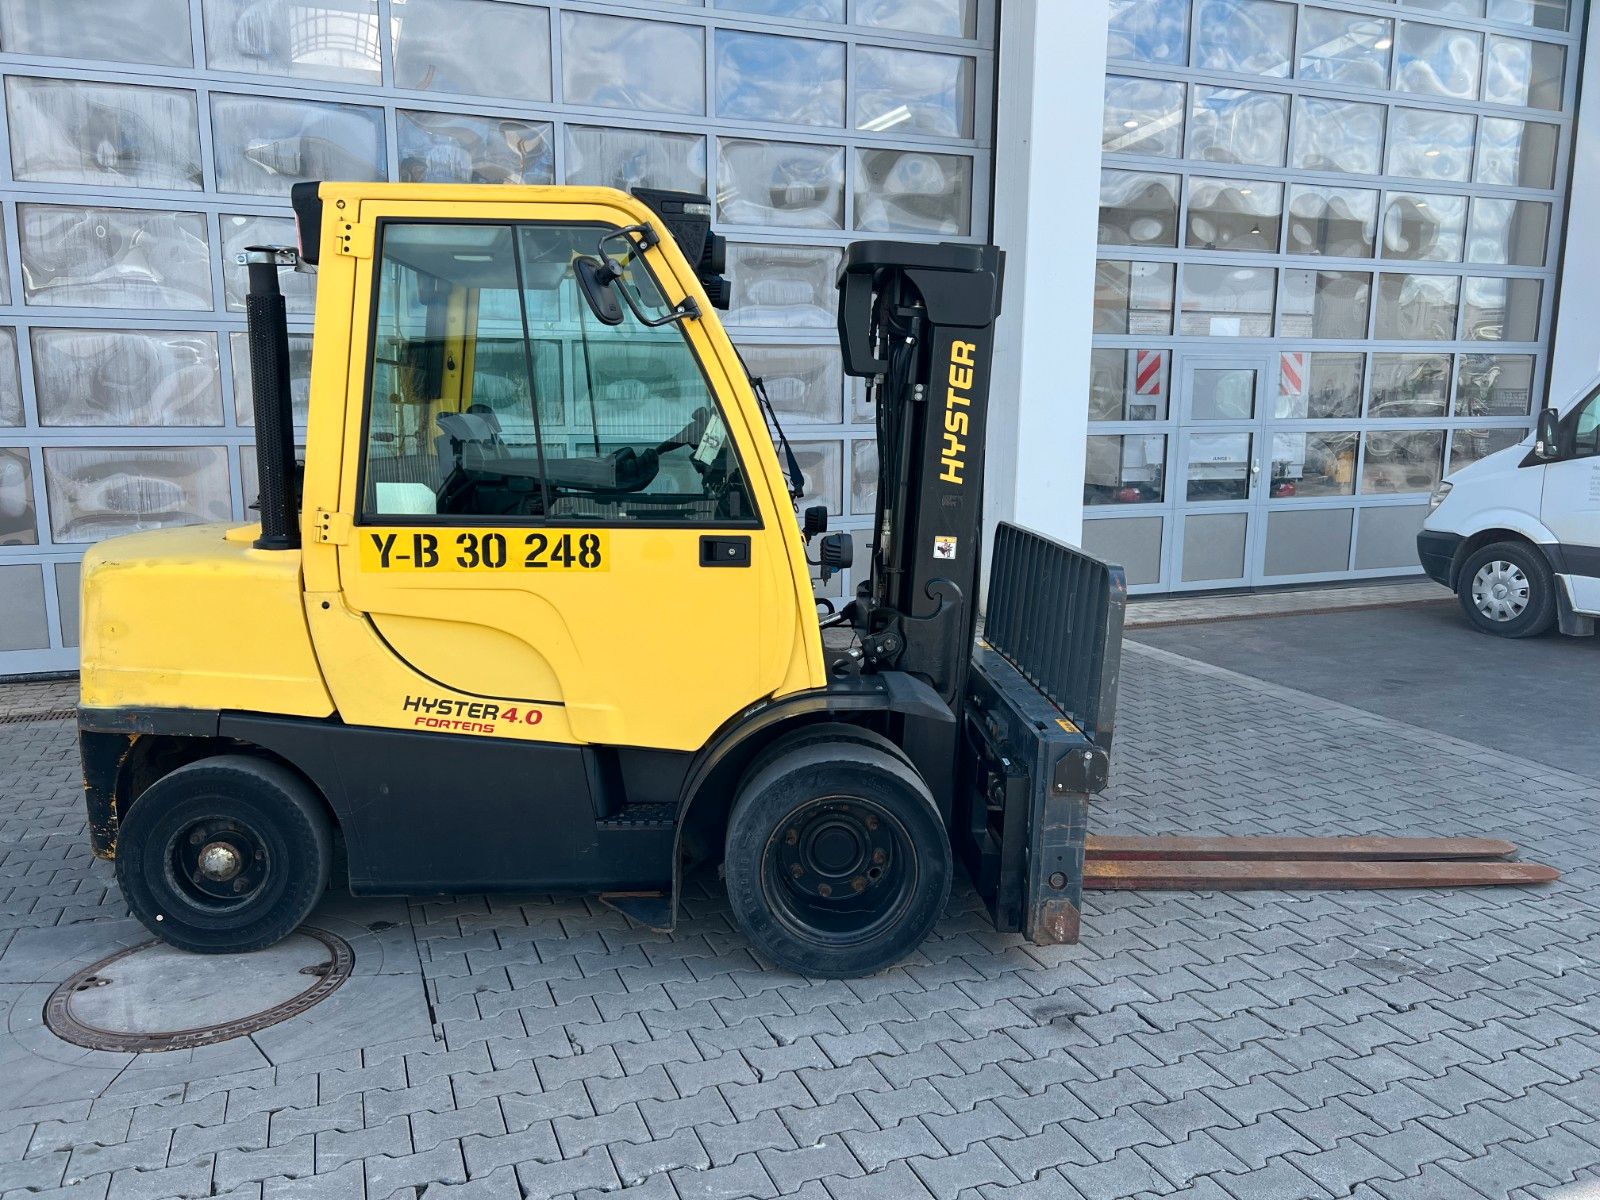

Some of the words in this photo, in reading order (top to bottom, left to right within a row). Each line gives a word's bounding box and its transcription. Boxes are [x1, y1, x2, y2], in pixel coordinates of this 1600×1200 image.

[939, 340, 976, 484] HYSTER
[370, 533, 439, 568] Y-B
[456, 533, 507, 569] 30
[524, 533, 601, 569] 248
[402, 695, 500, 720] HYSTER
[501, 707, 543, 725] 4.0
[414, 717, 495, 733] FORTENS
